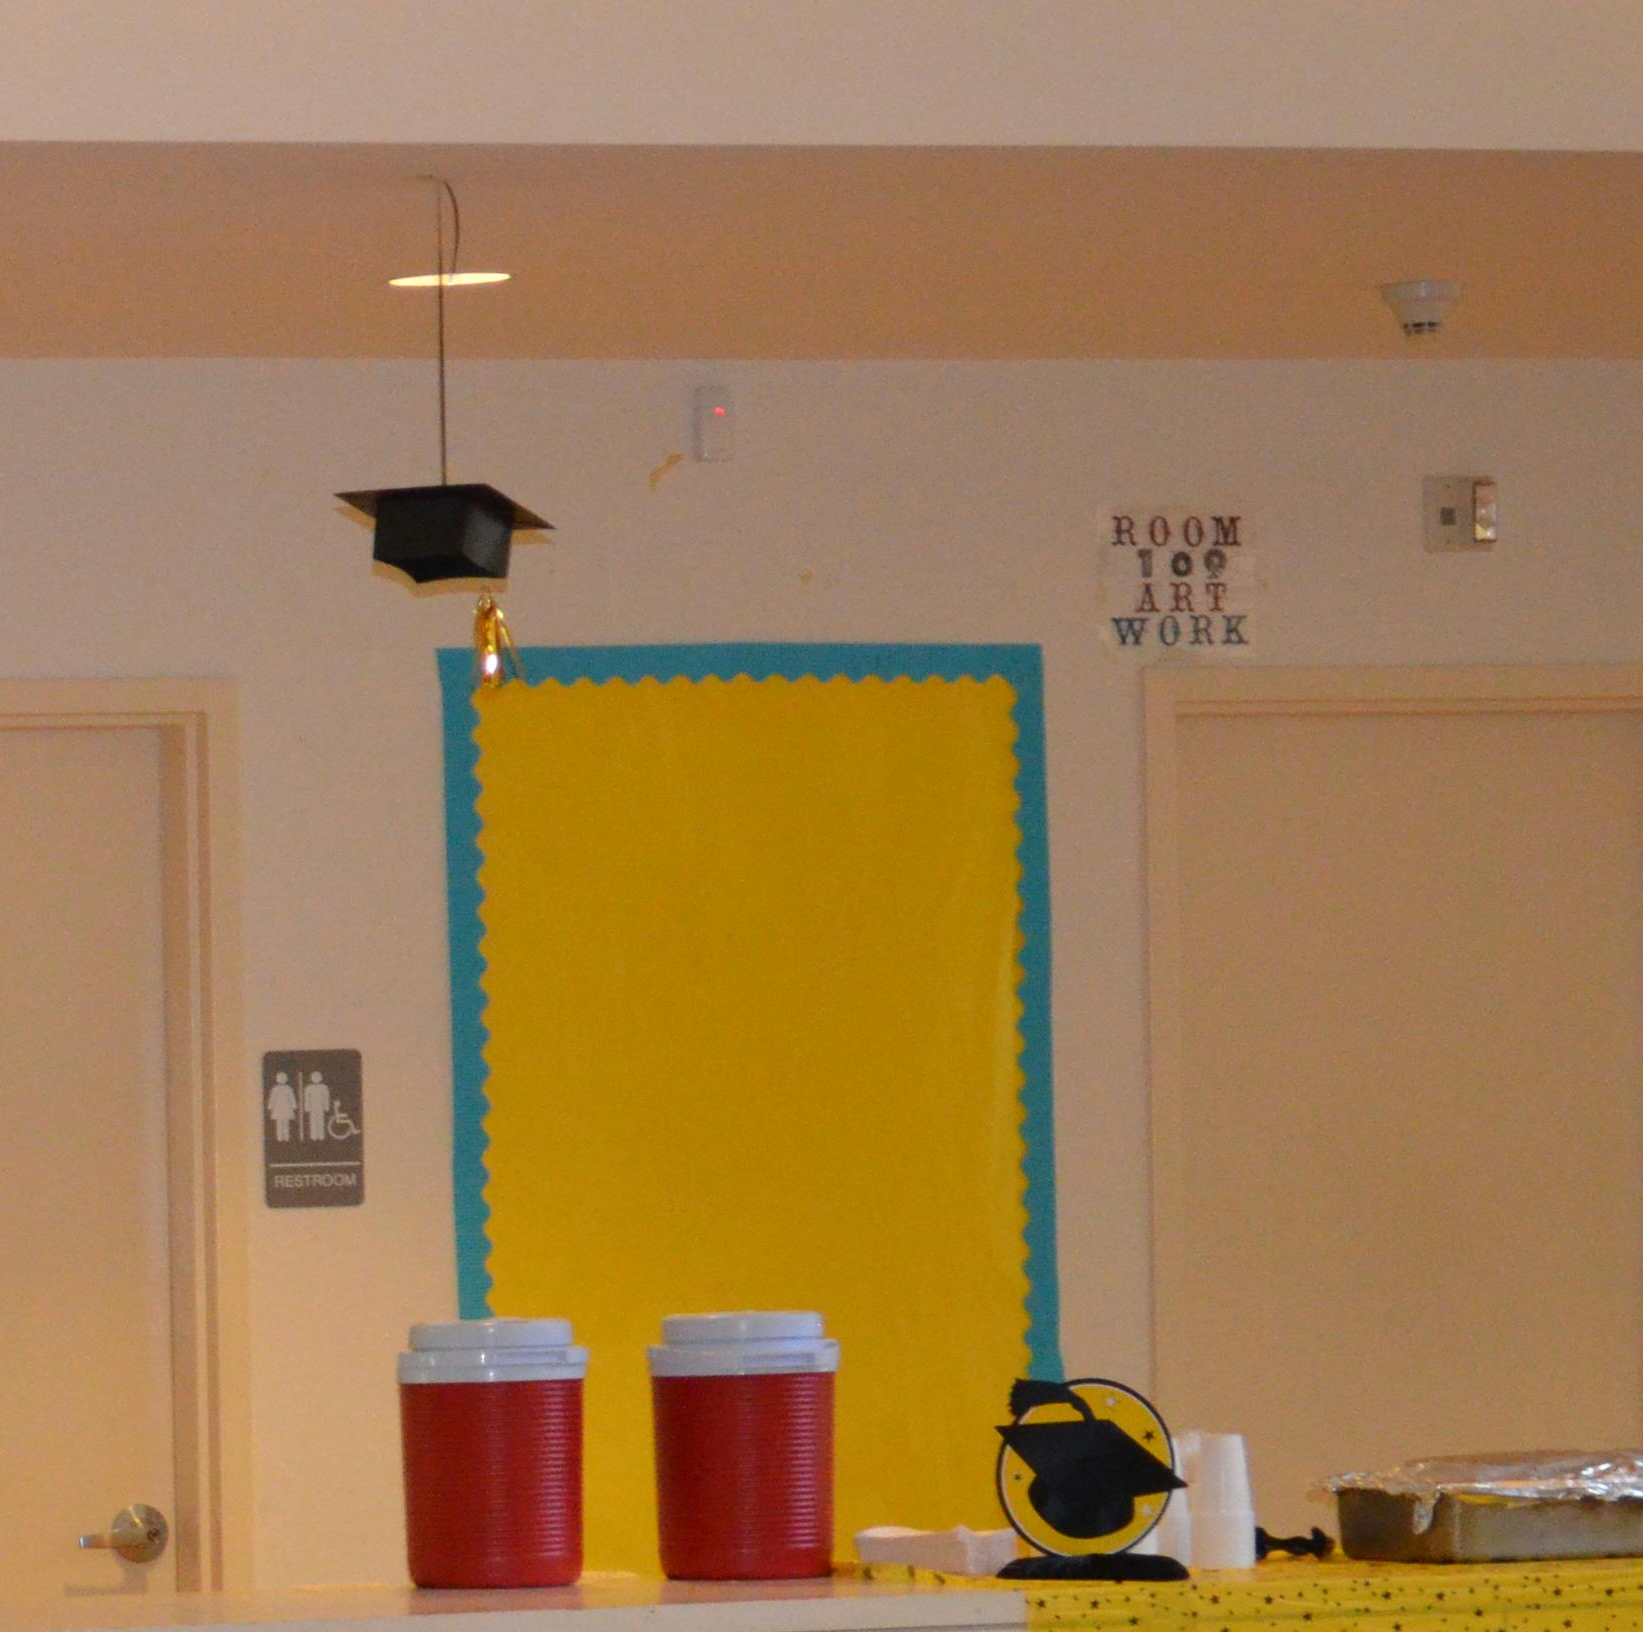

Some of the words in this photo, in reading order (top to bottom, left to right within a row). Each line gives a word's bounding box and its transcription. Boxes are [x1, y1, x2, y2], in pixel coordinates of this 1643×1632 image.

[1112, 515, 1242, 547] ROOM
[1134, 582, 1227, 613] ART
[1111, 615, 1249, 646] WORK
[274, 1172, 357, 1188] RESTROOM
